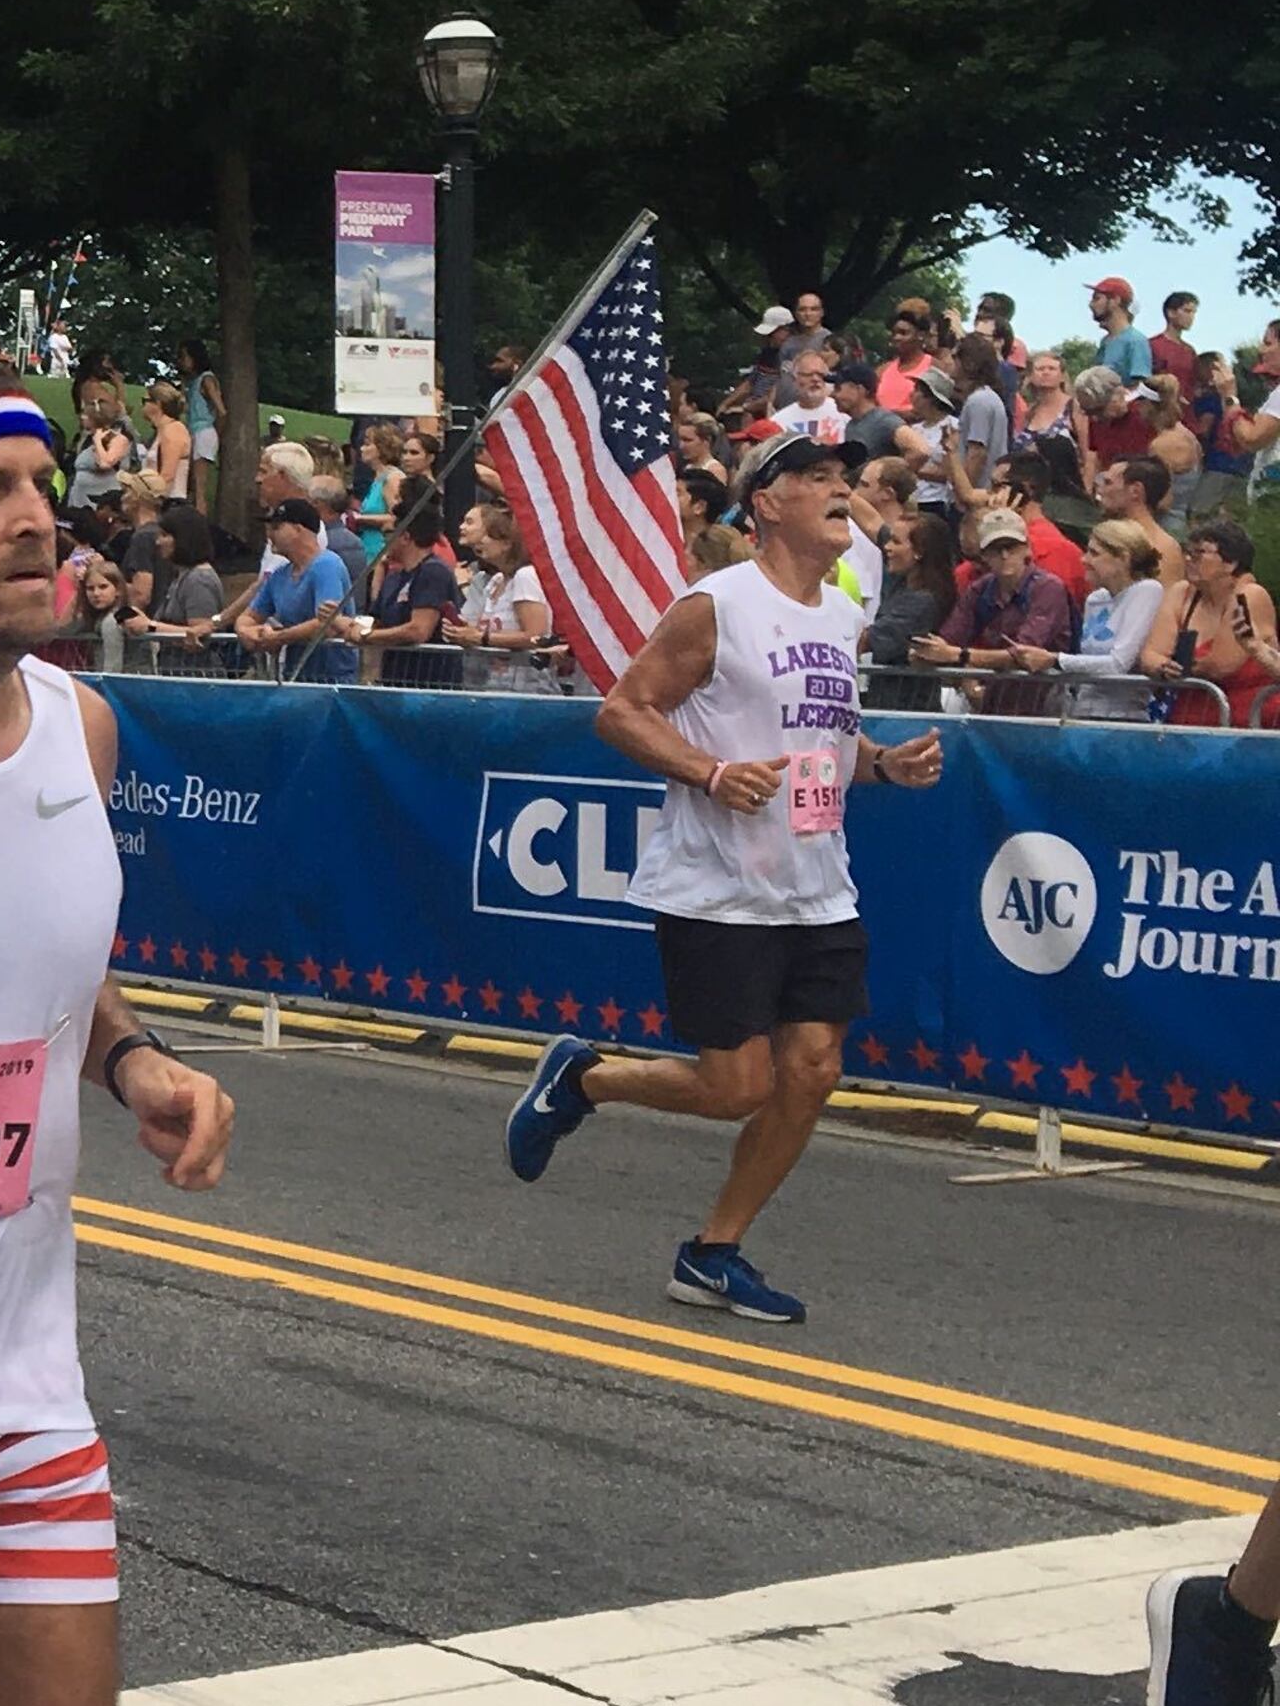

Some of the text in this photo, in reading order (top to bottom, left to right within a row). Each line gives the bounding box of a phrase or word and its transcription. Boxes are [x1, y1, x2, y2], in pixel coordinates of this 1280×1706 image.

[340, 201, 413, 215] PRESERVING
[340, 212, 407, 227] PIEDMONT
[340, 225, 374, 238] PARK
[794, 788, 807, 808] E
[1119, 850, 1235, 913] The
[998, 877, 1078, 935] AJC
